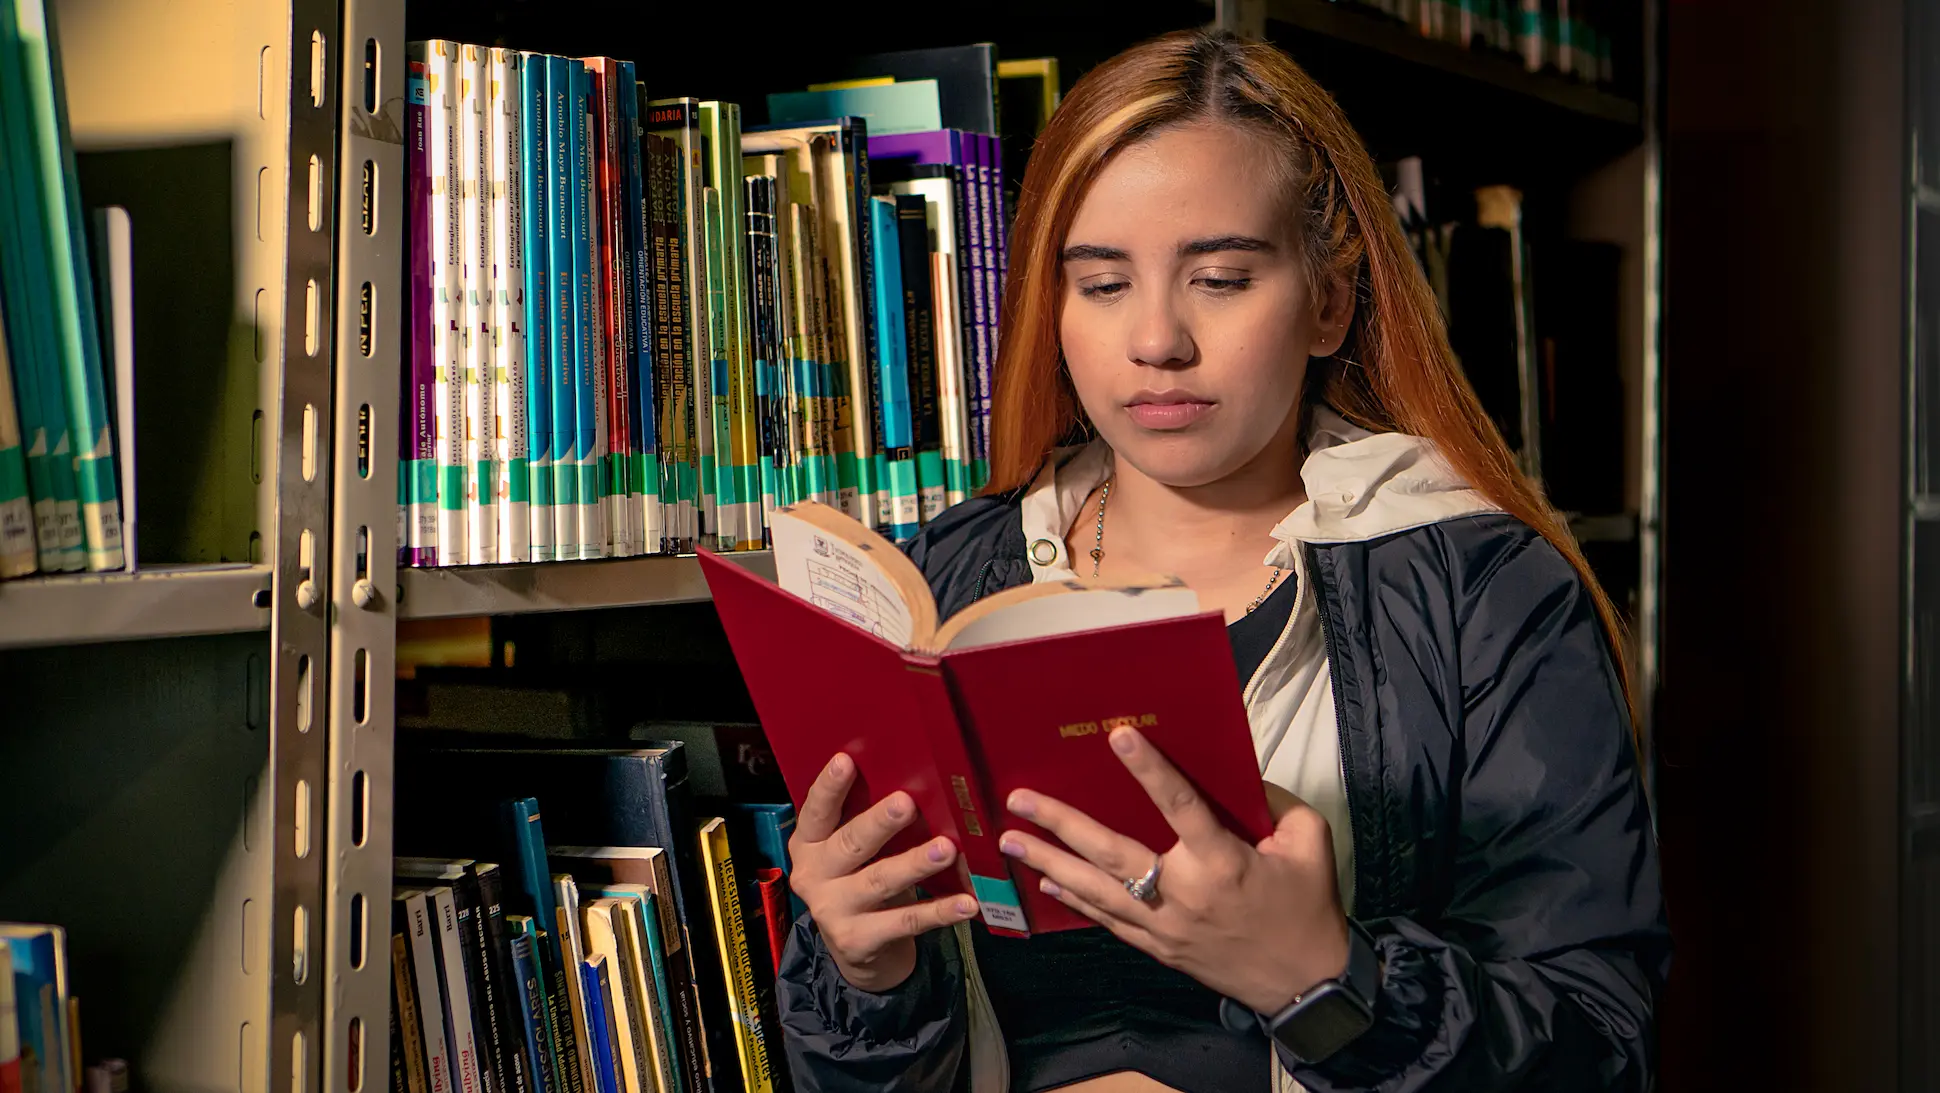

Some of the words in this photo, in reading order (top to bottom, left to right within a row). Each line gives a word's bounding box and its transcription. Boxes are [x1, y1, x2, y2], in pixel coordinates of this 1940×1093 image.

[578, 94, 586, 142] Arnobio
[416, 131, 424, 152] Joan
[536, 140, 544, 171] Maya
[557, 141, 566, 173] Maya
[578, 144, 586, 176] Maya
[966, 164, 976, 180] La
[978, 166, 990, 182] La
[559, 175, 567, 240] Betancourt
[580, 178, 588, 242] Betancourt
[967, 182, 980, 246] estructura
[980, 184, 992, 248] estructura
[654, 236, 667, 281] primaria
[668, 237, 682, 282] primaria
[971, 246, 982, 267] del
[984, 248, 996, 269] del
[624, 250, 632, 304] ORIENTACIÓN
[638, 250, 646, 304] ORIENTACIÓN
[973, 268, 985, 323] discurso
[560, 289, 568, 321] taller
[582, 291, 590, 322] taller
[656, 283, 668, 323] escuela
[670, 284, 682, 324] escuela
[986, 270, 998, 325] discurso
[626, 306, 634, 350] EDUCATIVA
[640, 305, 648, 348] EDUCATIVA
[657, 325, 668, 335] la
[658, 338, 669, 350] en
[672, 326, 682, 336] la
[672, 338, 684, 350] en
[562, 324, 570, 386] educativo
[583, 325, 591, 386] educativo
[974, 324, 989, 398] pedagógico
[419, 384, 427, 438] Autónomo
[1059, 721, 1098, 738] MIEDO
[414, 909, 425, 938] Barri
[443, 904, 454, 933] Barri
[476, 905, 487, 948] ESCOLAR
[489, 903, 500, 915] 225
[482, 952, 492, 982] ABUSO
[723, 858, 746, 937] Necesidades
[738, 940, 761, 1011] Educativas
[752, 1014, 772, 1082] Especiales
[486, 984, 494, 1000] DEL
[547, 994, 556, 1005] La
[554, 970, 568, 1011] ALUMNOS
[678, 991, 690, 1019] social
[490, 1003, 500, 1044] ROSTROS
[548, 1006, 564, 1052] Universidad
[561, 1014, 572, 1032] LOS
[512, 1053, 522, 1074] acoso
[684, 1028, 700, 1072] educativo
